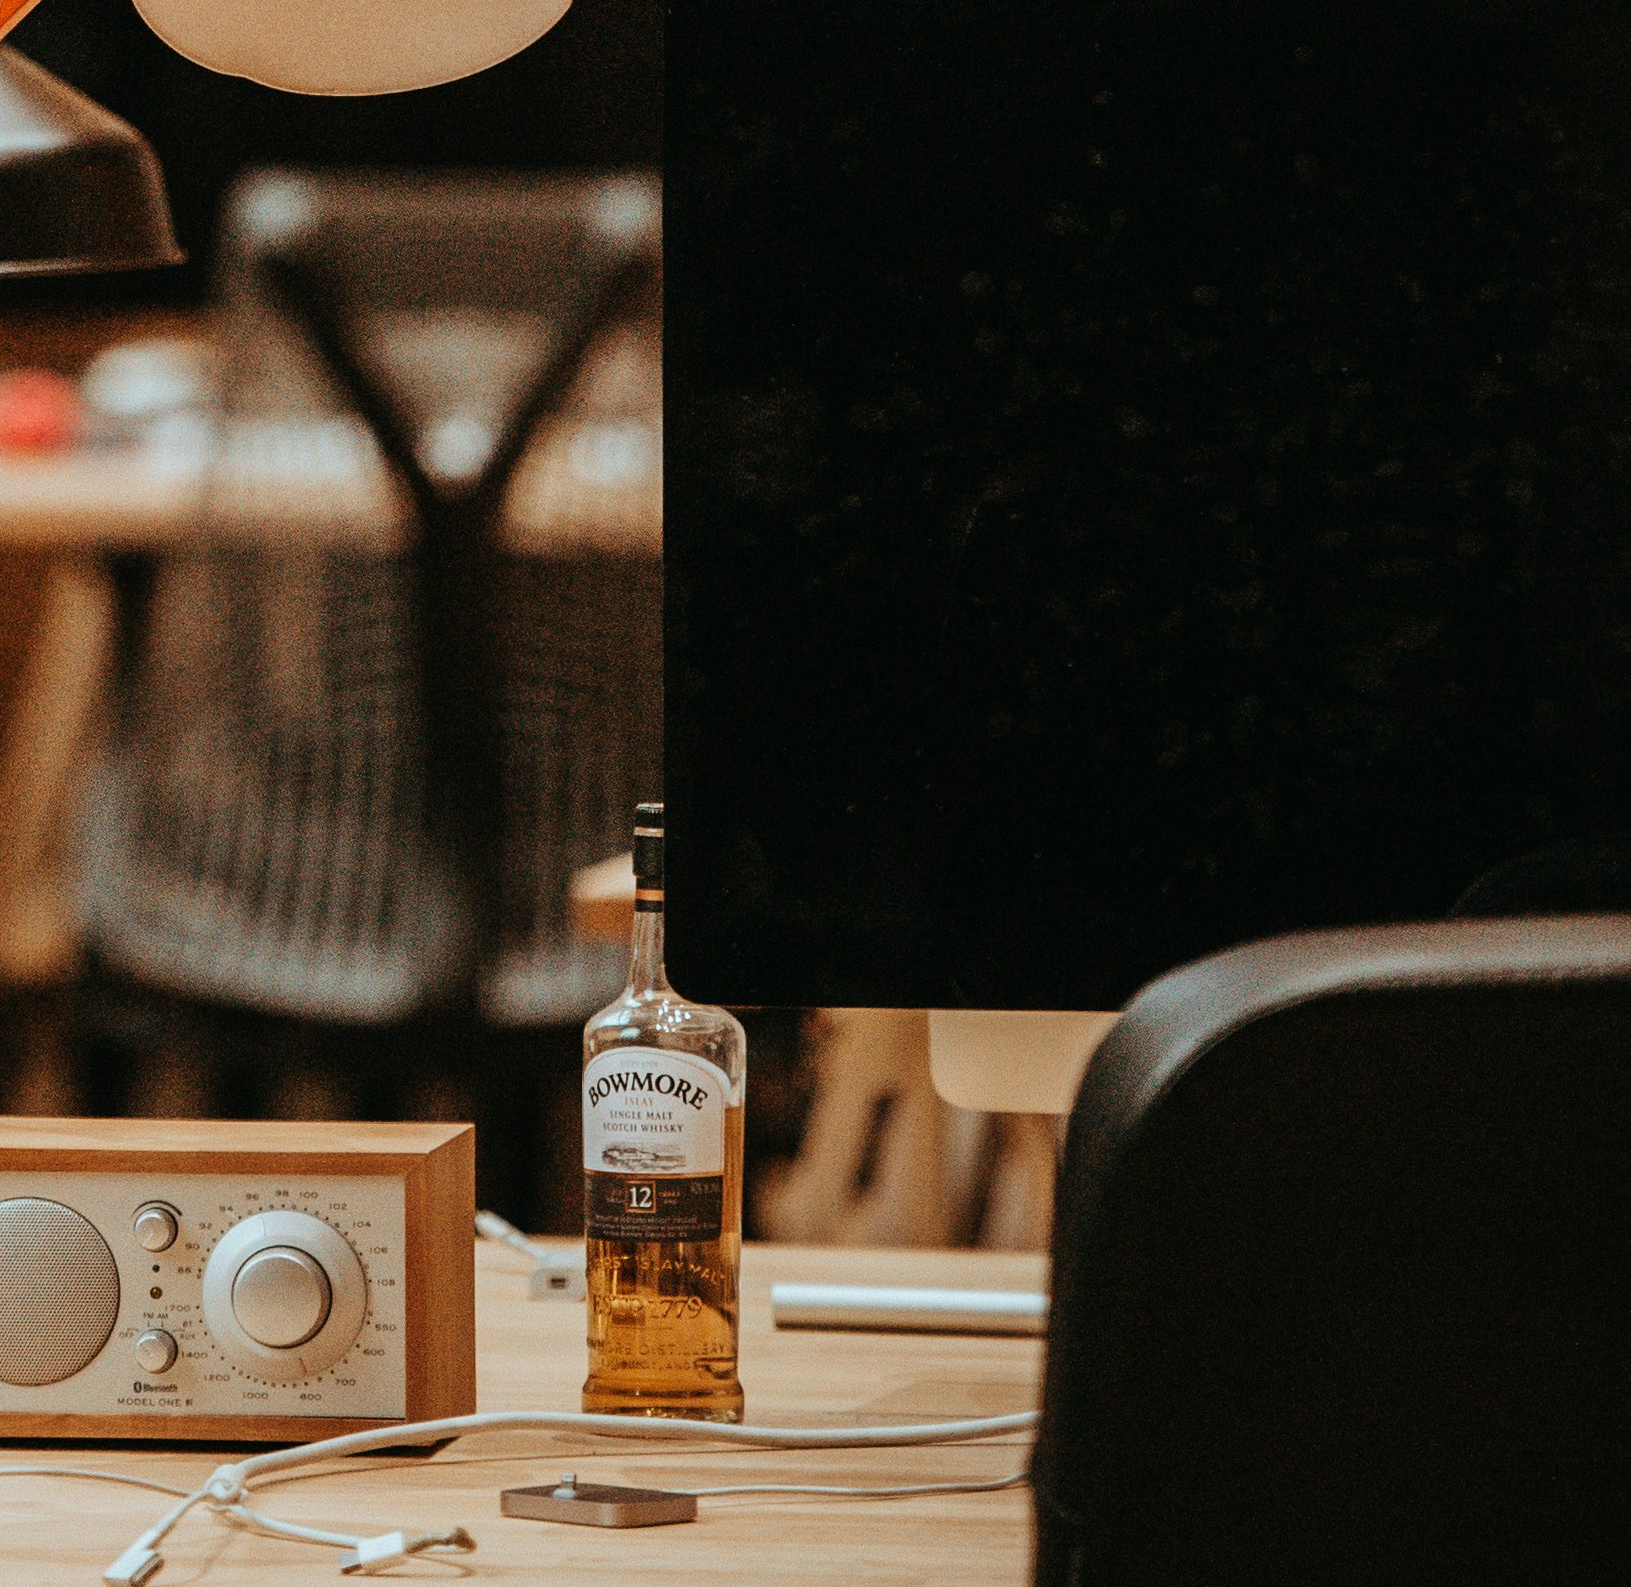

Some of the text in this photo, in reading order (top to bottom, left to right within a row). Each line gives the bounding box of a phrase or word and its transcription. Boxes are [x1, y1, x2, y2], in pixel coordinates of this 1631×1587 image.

[588, 1072, 708, 1111] BOWMORE
[624, 1097, 655, 1106] ISLAY
[609, 1111, 673, 1121] SINGLE MALT
[602, 1123, 684, 1133] SCOTCH WHISKY
[300, 1191, 319, 1199] 100
[629, 1186, 653, 1208] 12
[185, 1243, 200, 1251] 90
[369, 1247, 388, 1255] 106
[363, 1348, 385, 1356] 600
[335, 1378, 357, 1386] 700
[243, 1392, 269, 1400] 1000
[117, 1398, 155, 1406] MODEL
[158, 1399, 182, 1407] ONE
